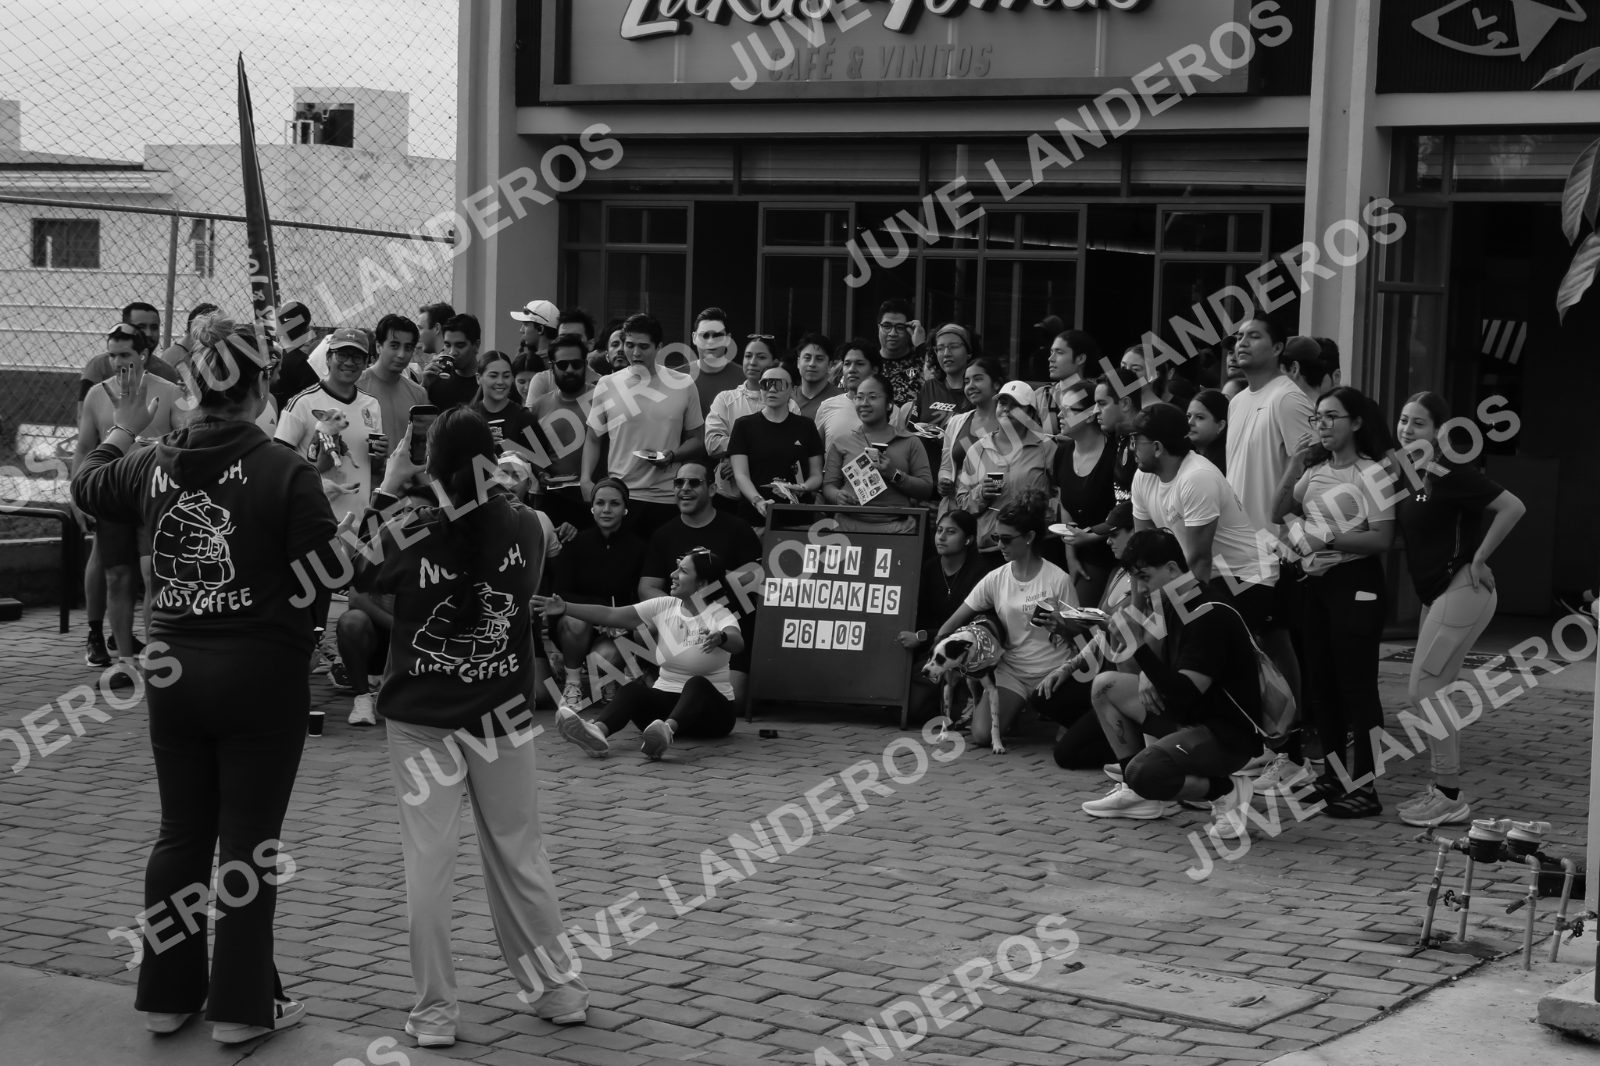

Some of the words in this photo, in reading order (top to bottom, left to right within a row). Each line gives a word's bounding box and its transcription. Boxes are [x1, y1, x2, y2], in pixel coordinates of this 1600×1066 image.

[767, 38, 836, 80] CAFÉ
[846, 47, 864, 79] &
[880, 45, 993, 79] VINITOS
[928, 401, 956, 412] CREEL
[805, 547, 860, 572] RUN
[876, 552, 890, 575] 4
[156, 586, 192, 608] JUST
[192, 587, 253, 615] COFFEE
[766, 580, 899, 612] PANCAKES
[784, 621, 864, 647] 26.09
[458, 653, 519, 683] COFFEE
